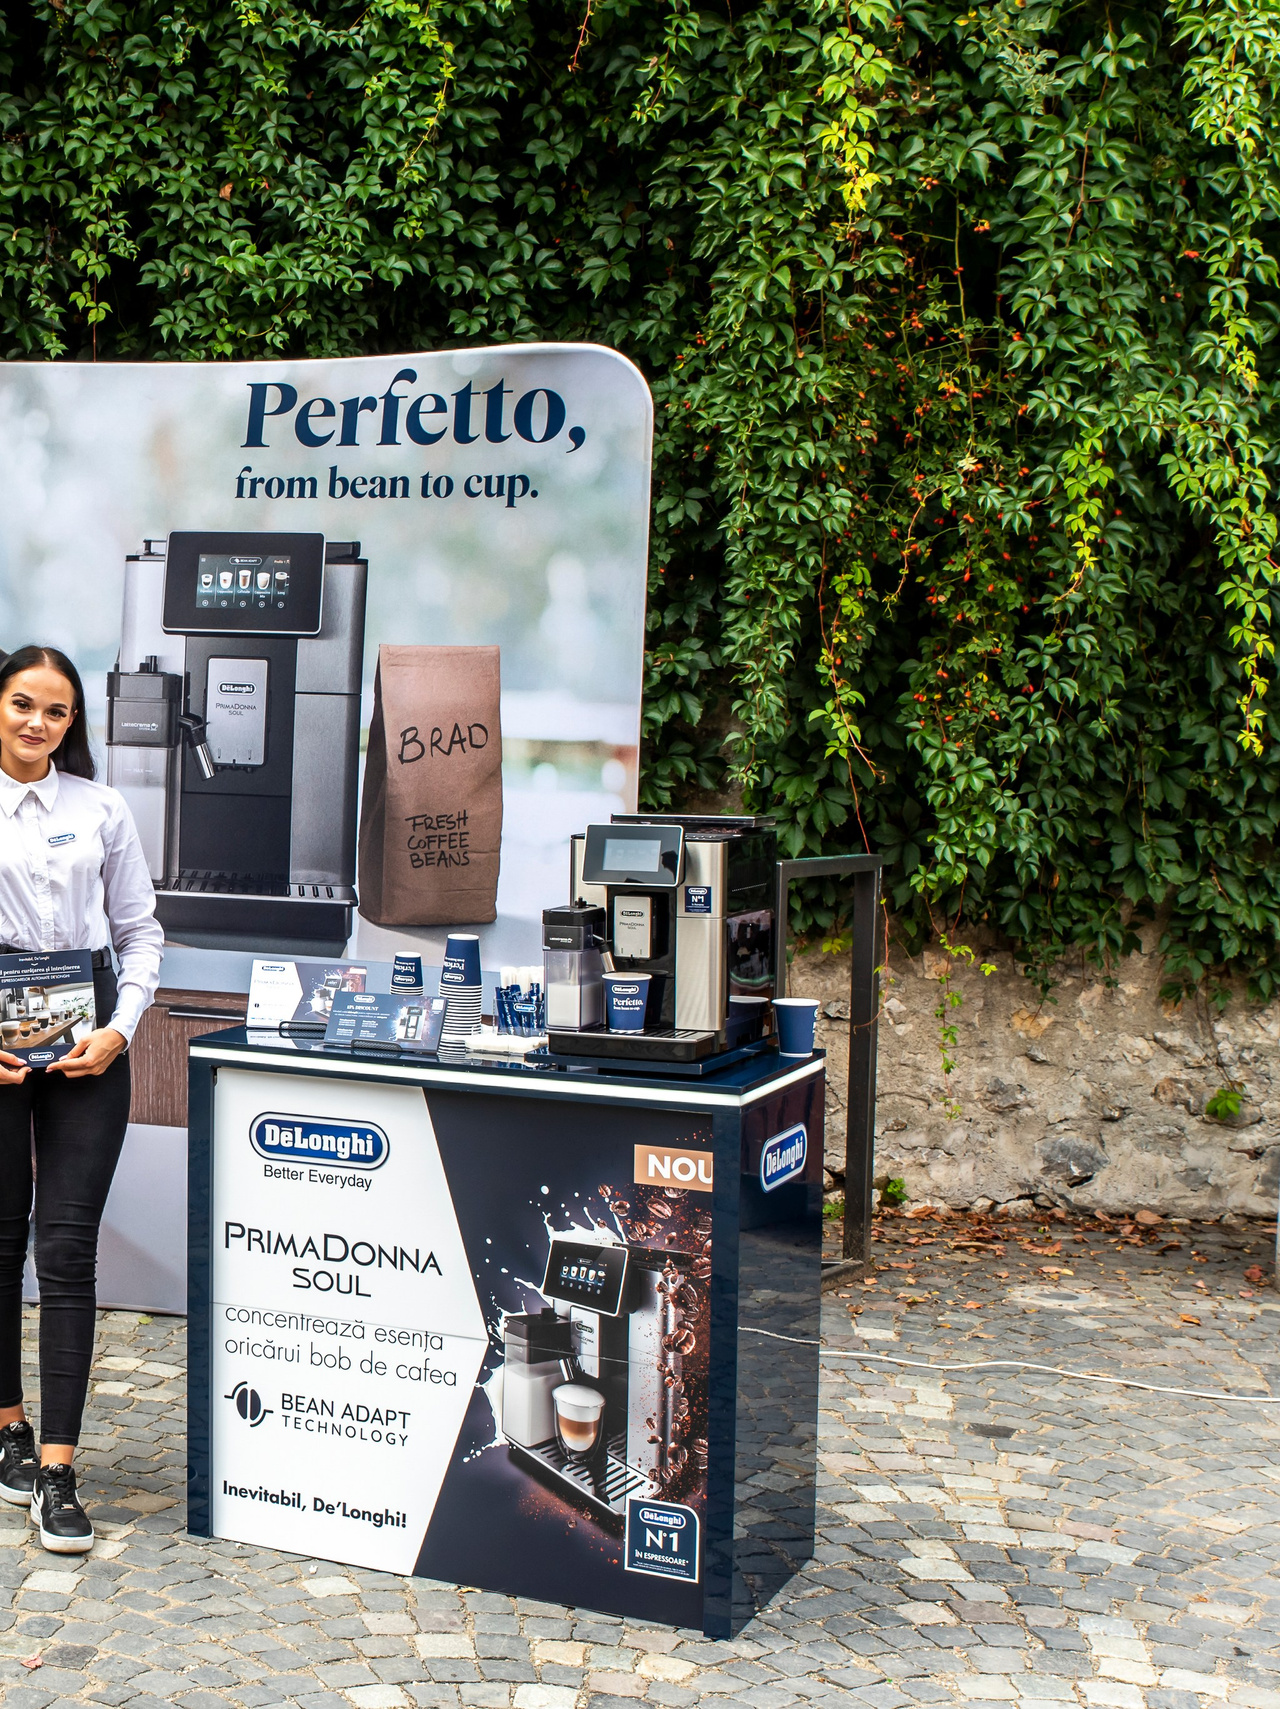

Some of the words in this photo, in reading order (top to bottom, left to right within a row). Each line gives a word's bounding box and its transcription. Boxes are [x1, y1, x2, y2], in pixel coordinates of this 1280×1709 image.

[240, 368, 586, 454] Perfetto,
[234, 465, 318, 499] from
[328, 465, 410, 499] bean
[420, 471, 454, 499] to
[463, 474, 539, 508] cup.
[398, 722, 489, 765] BRAD
[404, 809, 469, 832] FRESH
[407, 832, 470, 850] COFFEE
[409, 850, 470, 869] BEANS
[3, 967, 21, 977] pentru
[263, 1164, 304, 1181] Better
[308, 1169, 373, 1191] Everyday
[647, 1153, 713, 1185] NOU
[292, 1267, 372, 1297] SOUL
[225, 1306, 365, 1339] concentrează
[374, 1327, 444, 1352] esența
[225, 1337, 300, 1363] oricărui
[310, 1342, 351, 1371] bob
[359, 1350, 387, 1376] de
[395, 1358, 457, 1387] cafea
[281, 1393, 334, 1417] BEAN
[341, 1403, 411, 1429] ADAPT
[282, 1415, 409, 1446] TECHNOLOGY
[223, 1480, 307, 1512] Inevitabil,
[313, 1497, 407, 1528] De'Longhi!
